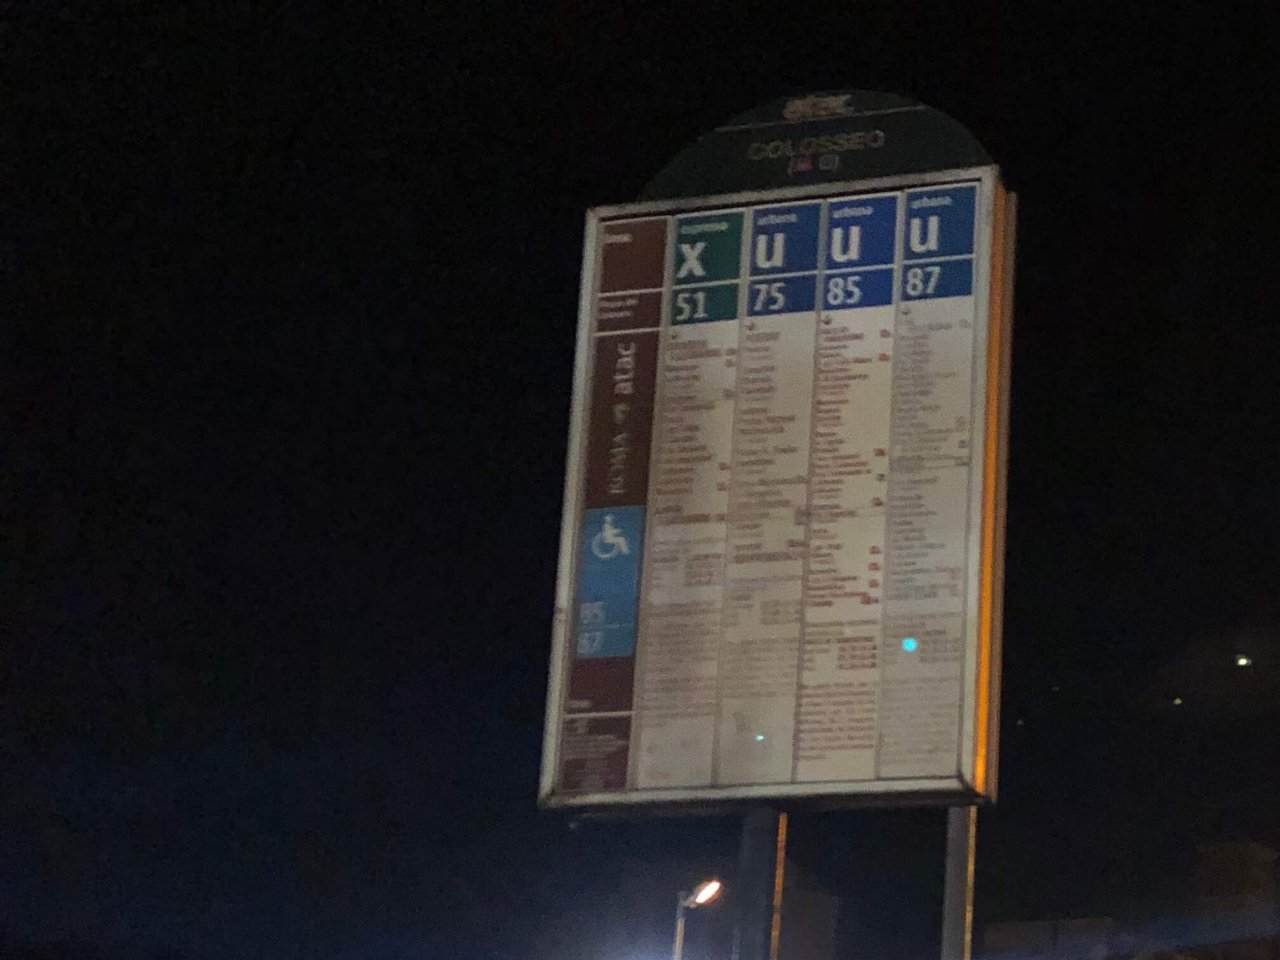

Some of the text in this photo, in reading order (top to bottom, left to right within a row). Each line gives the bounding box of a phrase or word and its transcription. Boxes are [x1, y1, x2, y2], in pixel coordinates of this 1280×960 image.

[752, 281, 786, 312] 75
[826, 275, 863, 306] 85
[905, 265, 941, 297] 87
[675, 291, 708, 321] 51
